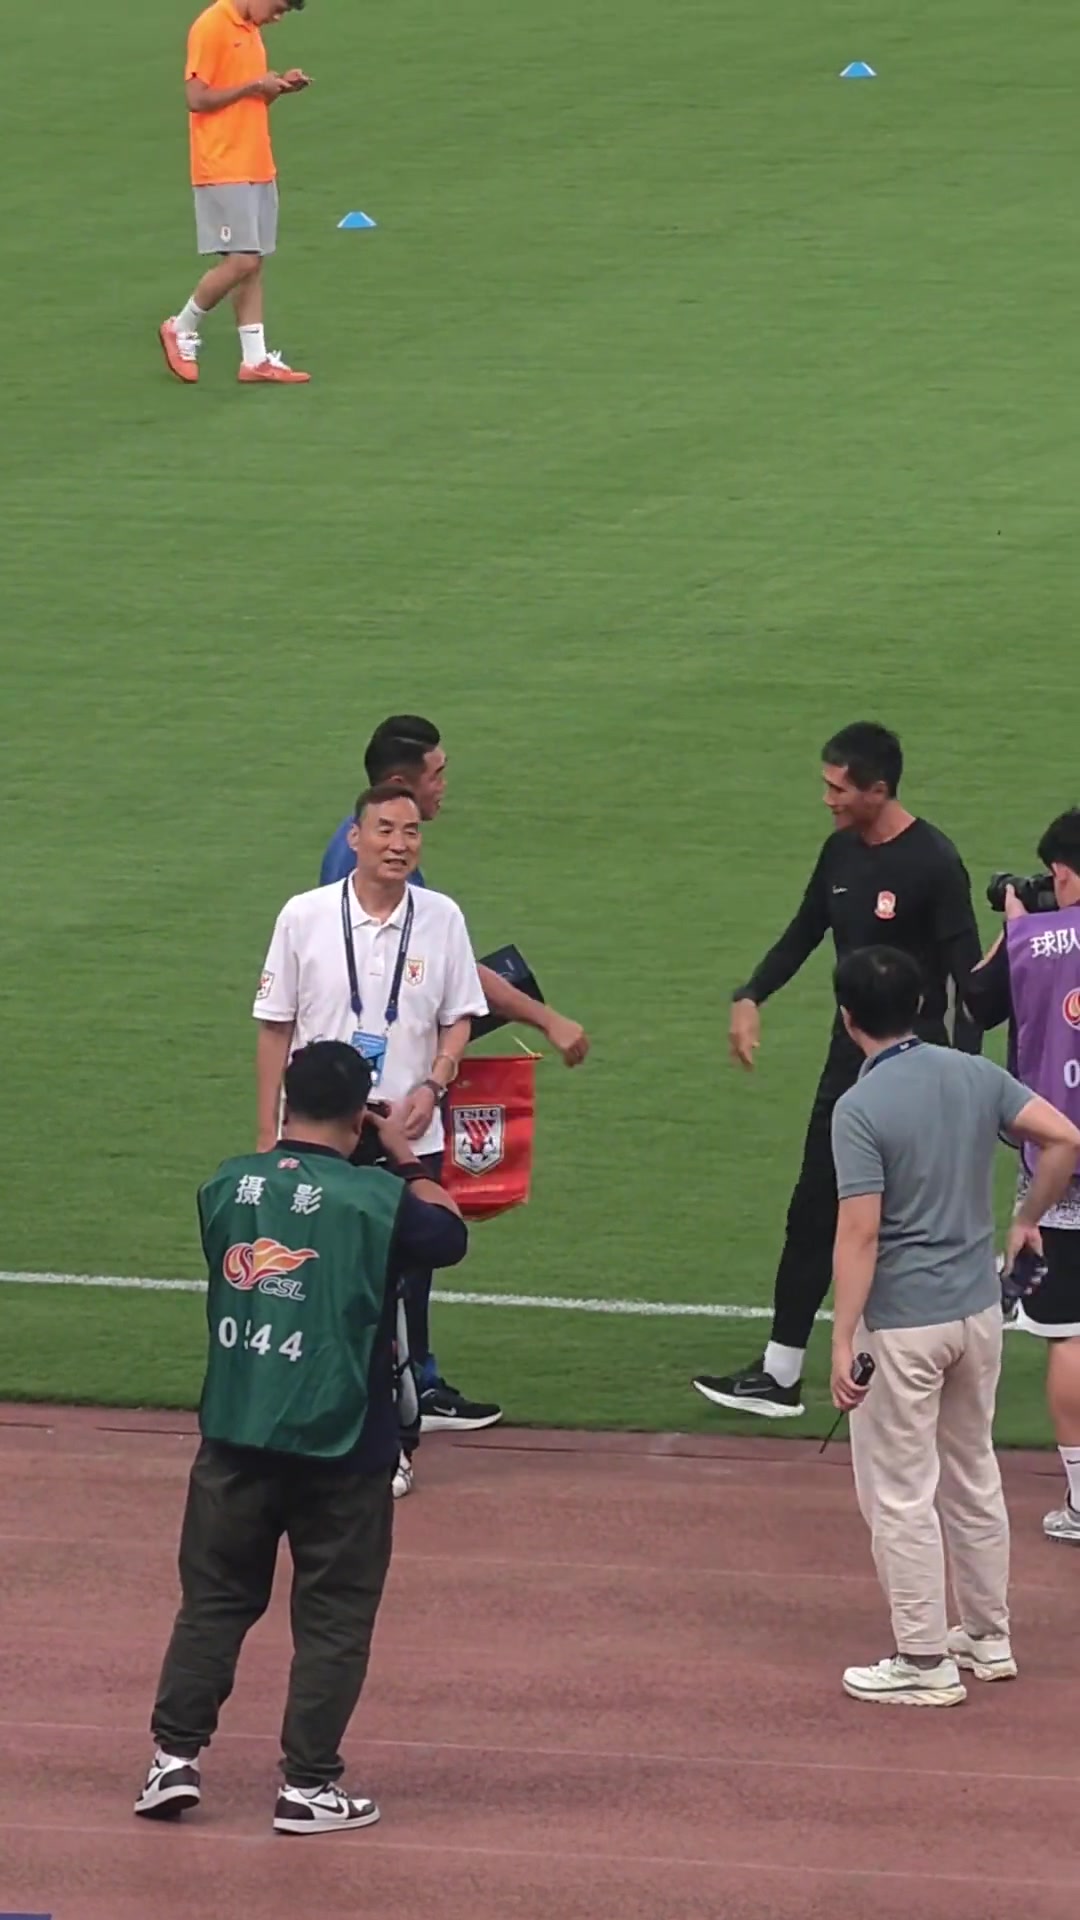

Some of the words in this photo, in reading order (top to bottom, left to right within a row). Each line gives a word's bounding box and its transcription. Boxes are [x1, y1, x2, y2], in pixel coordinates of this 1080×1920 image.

[1030, 927, 1080, 958] 球队
[234, 1174, 323, 1215] 摄影
[258, 1275, 306, 1301] CSL
